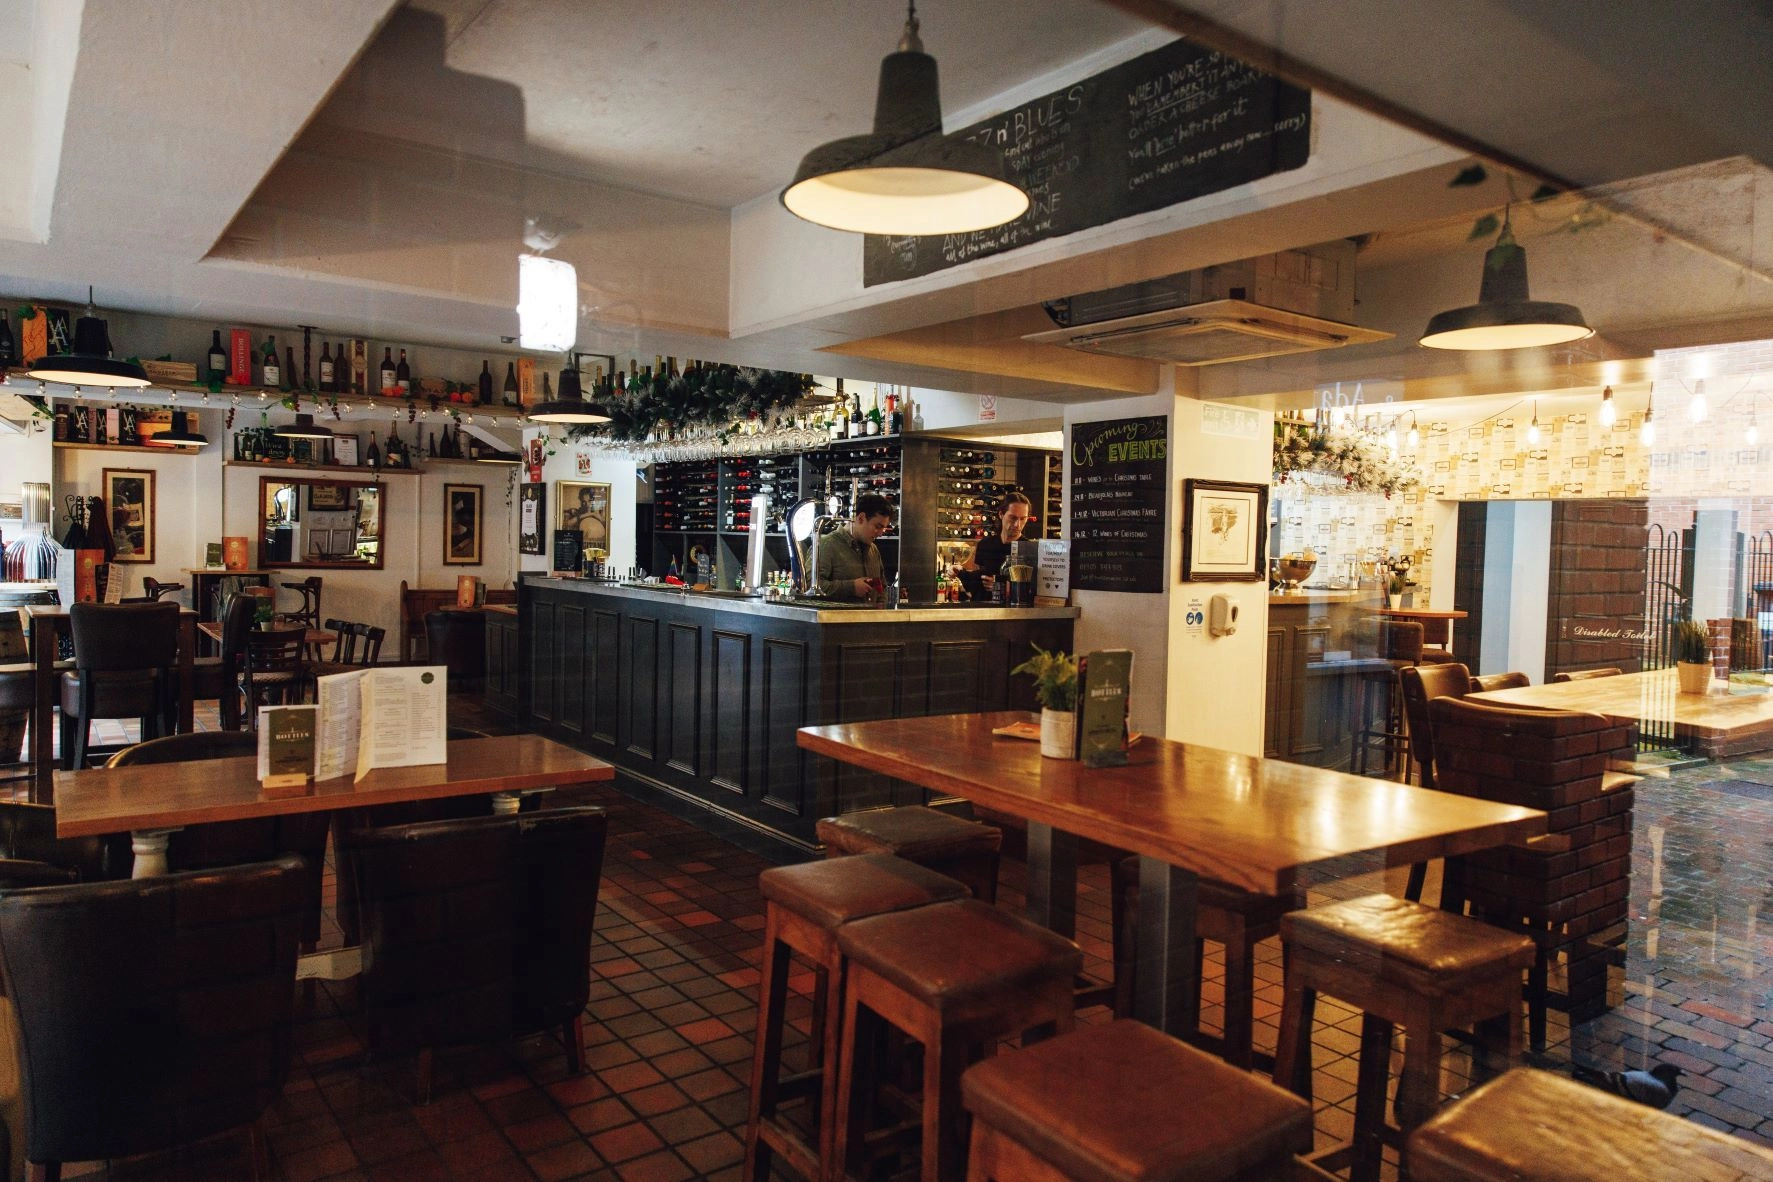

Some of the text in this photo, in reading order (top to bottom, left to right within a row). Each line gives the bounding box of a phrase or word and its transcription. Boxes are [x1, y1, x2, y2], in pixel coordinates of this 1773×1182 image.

[1014, 85, 1085, 144] BLUES
[1073, 422, 1138, 467] Upcoming
[1108, 439, 1166, 462] EVENTS
[1091, 509, 1116, 518] VICTORIAN
[1116, 508, 1141, 518] CHRISTMAS
[1573, 625, 1656, 640] Disabled Toilet
